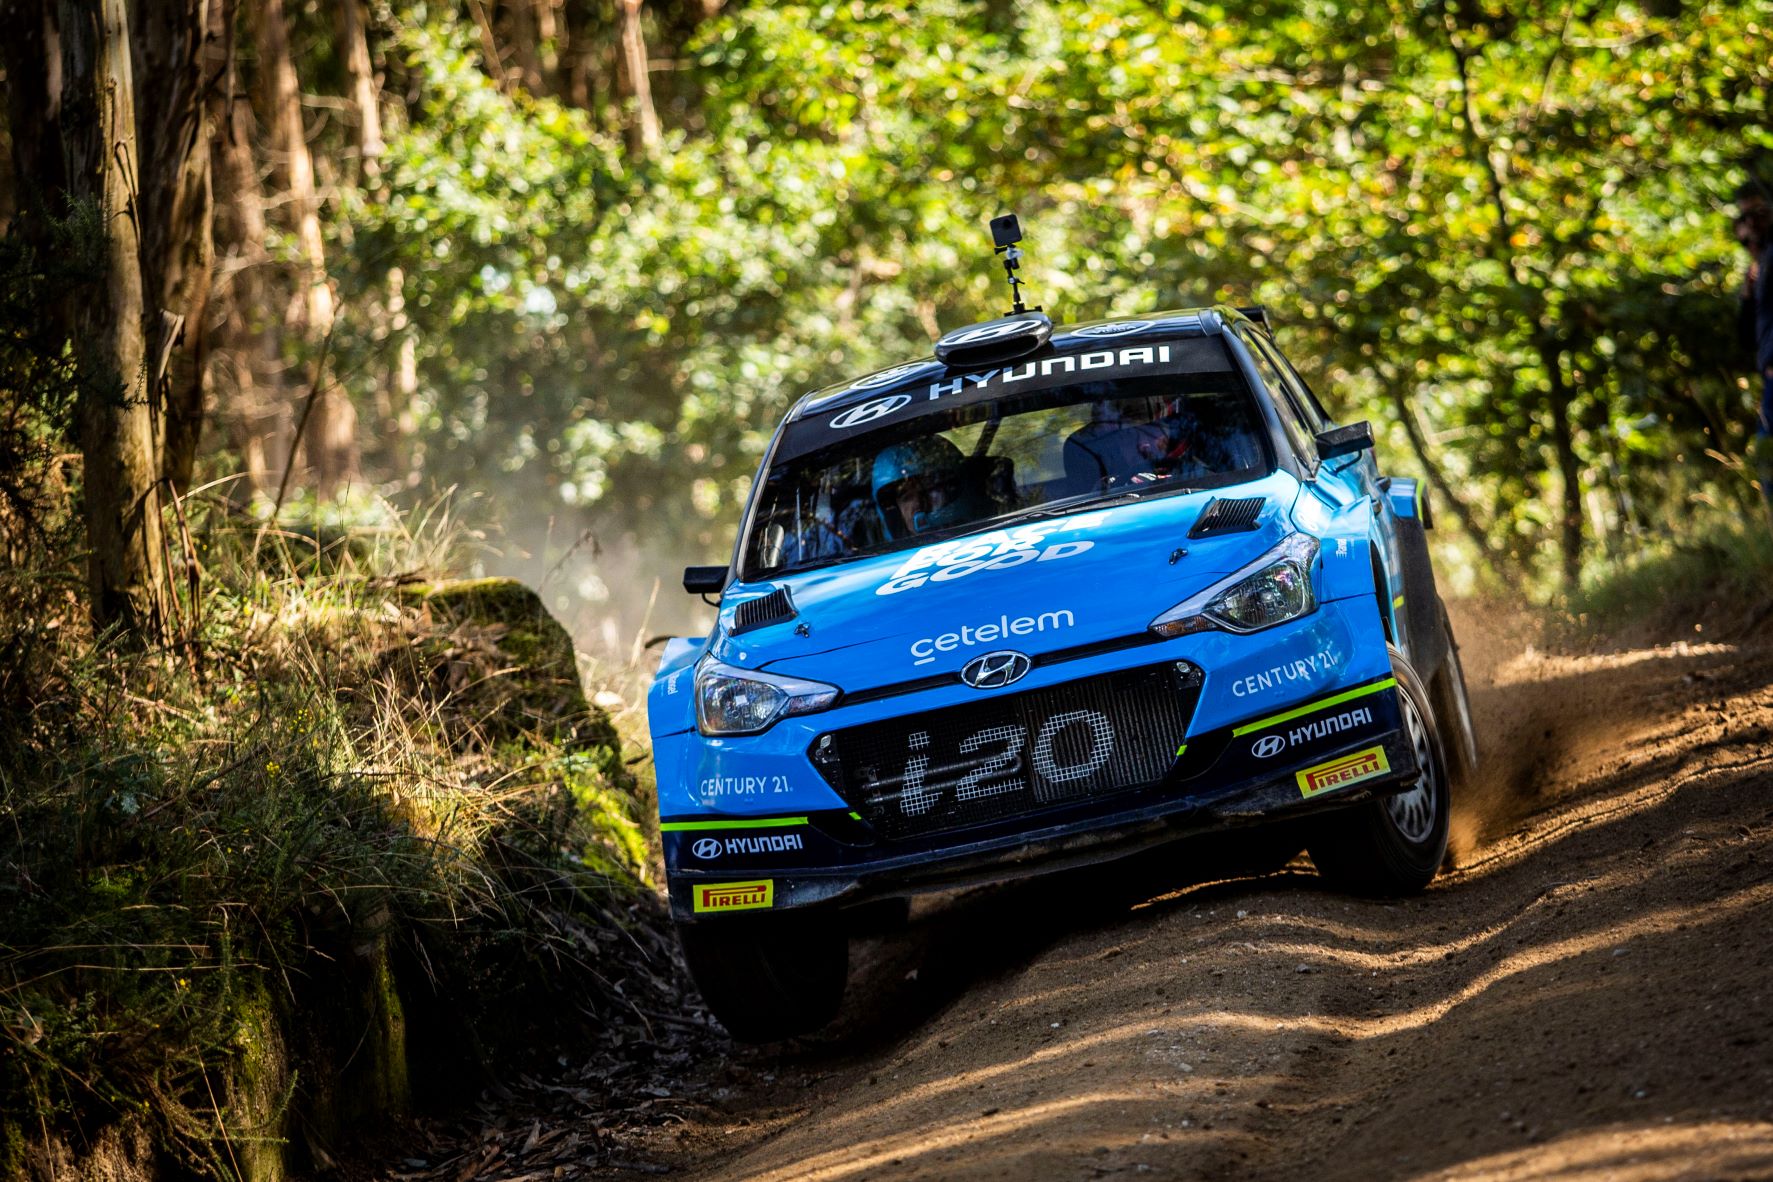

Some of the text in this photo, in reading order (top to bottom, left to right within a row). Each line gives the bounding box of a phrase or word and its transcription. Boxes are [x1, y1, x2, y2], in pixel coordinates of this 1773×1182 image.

[930, 345, 1170, 400] HYUNDAI
[875, 541, 1095, 596] GOOD
[911, 609, 1074, 666] cetelem
[1232, 656, 1318, 697] CENTURY
[1289, 707, 1372, 746] HYUNDAI
[900, 710, 1114, 817] i20
[1306, 753, 1380, 791] PIRELLI
[700, 777, 767, 797] CENTURY
[725, 834, 803, 854] HYUNDAI
[703, 886, 767, 907] PIRELLI
